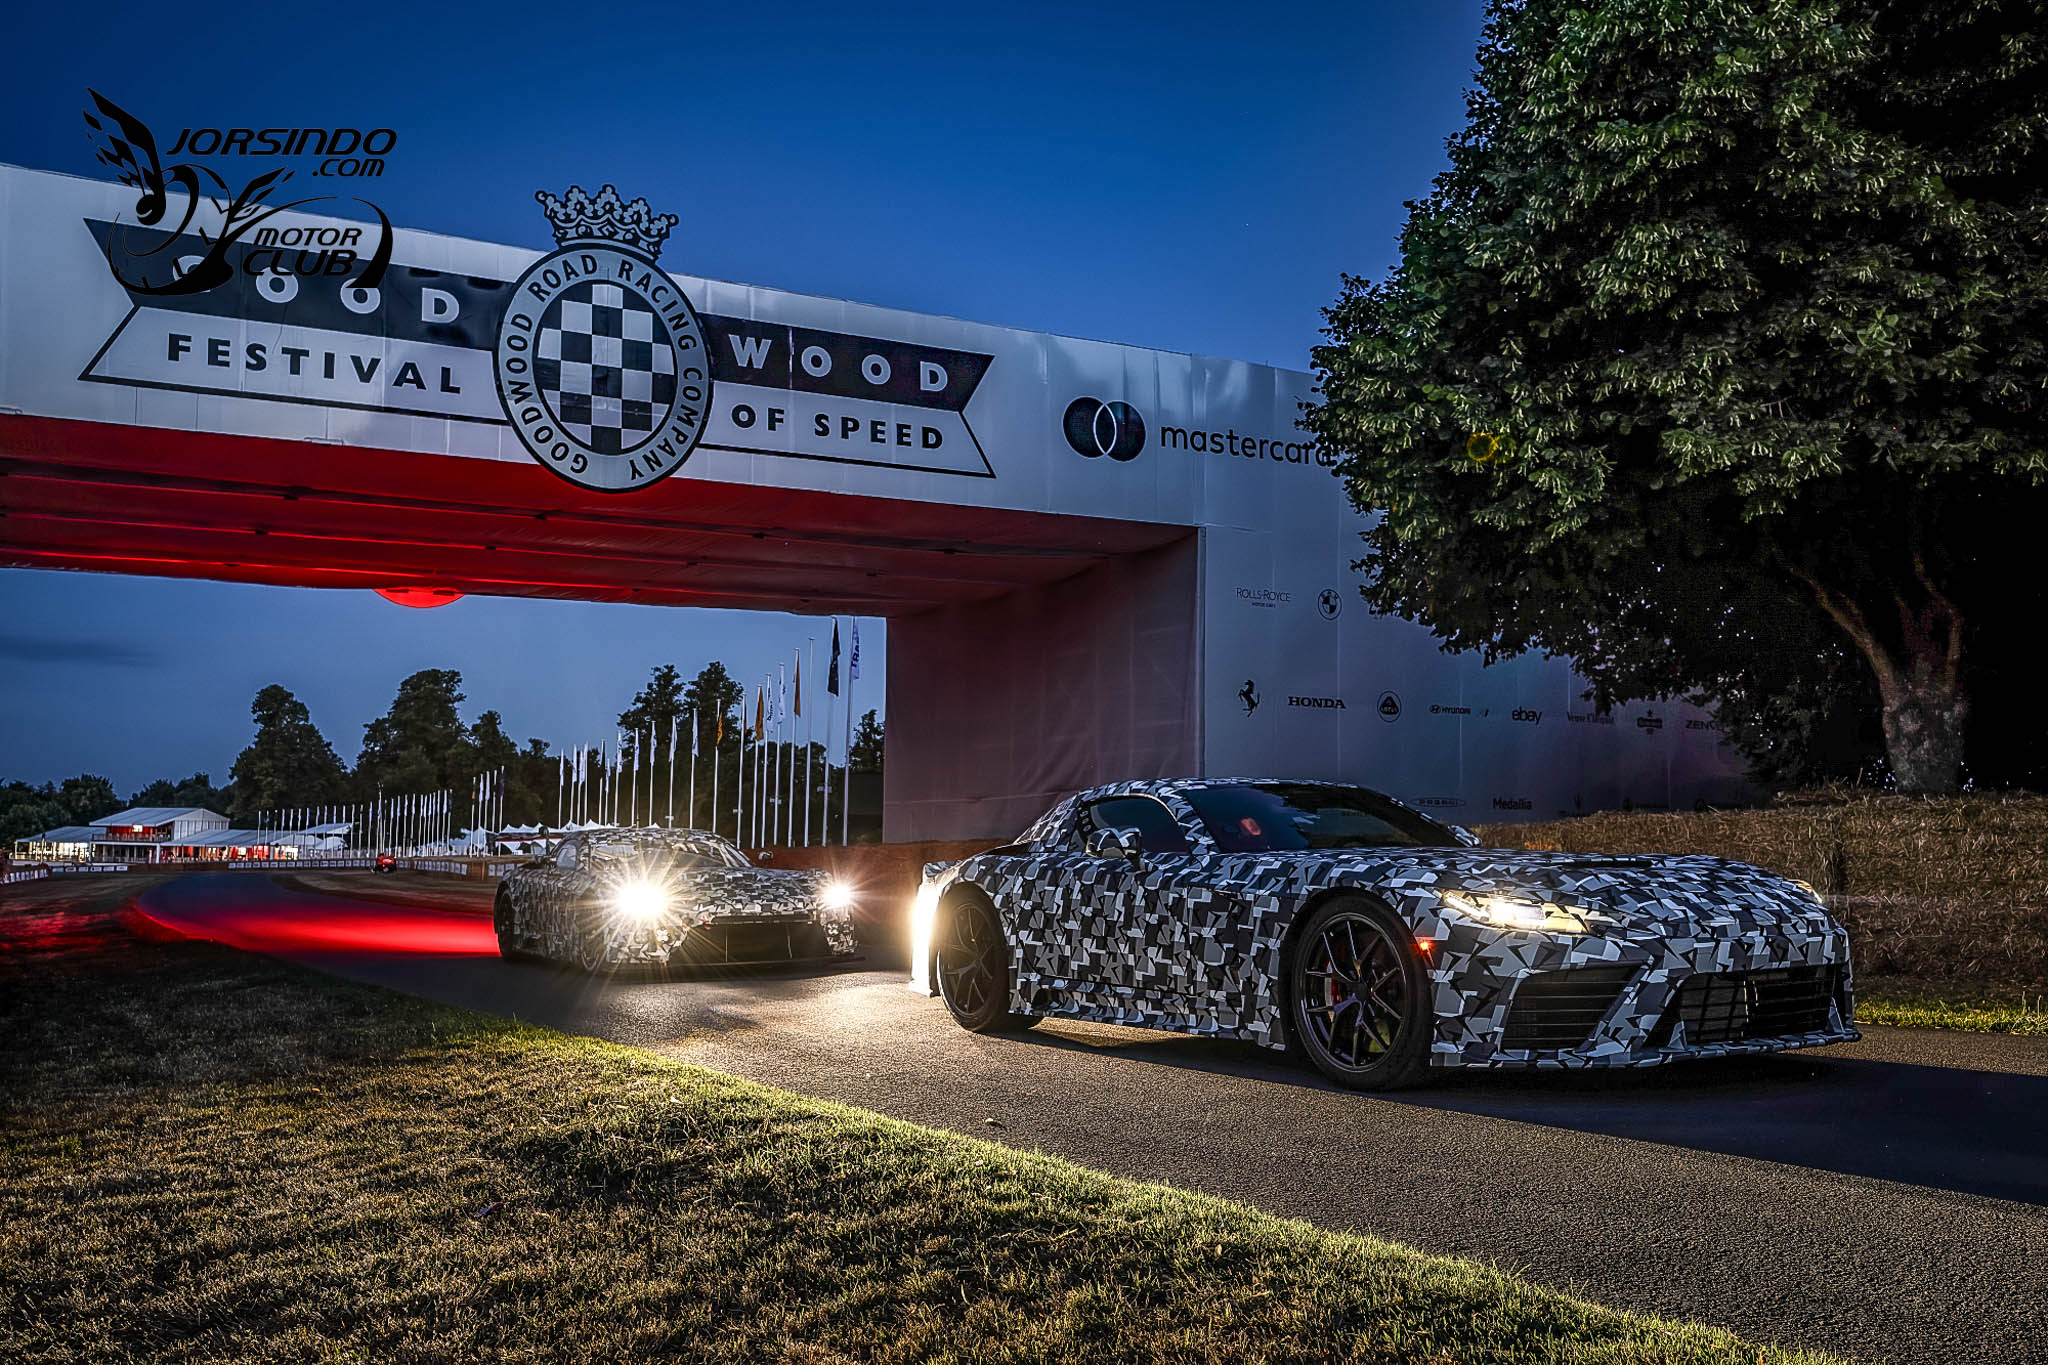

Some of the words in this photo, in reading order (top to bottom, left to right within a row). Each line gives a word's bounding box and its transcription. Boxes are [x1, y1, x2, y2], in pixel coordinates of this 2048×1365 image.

[528, 254, 598, 302] ROAD
[617, 260, 697, 351] RACING
[167, 332, 461, 394] FESTIVAL
[728, 334, 949, 393] WOOD
[506, 313, 588, 474] GOODWOOD
[629, 367, 702, 481] COMPANY
[731, 403, 785, 432] OF
[813, 413, 944, 449] SPEED
[1287, 696, 1346, 709] HONDA
[1512, 705, 1542, 725] ebay
[1493, 797, 1533, 810] Medallia
